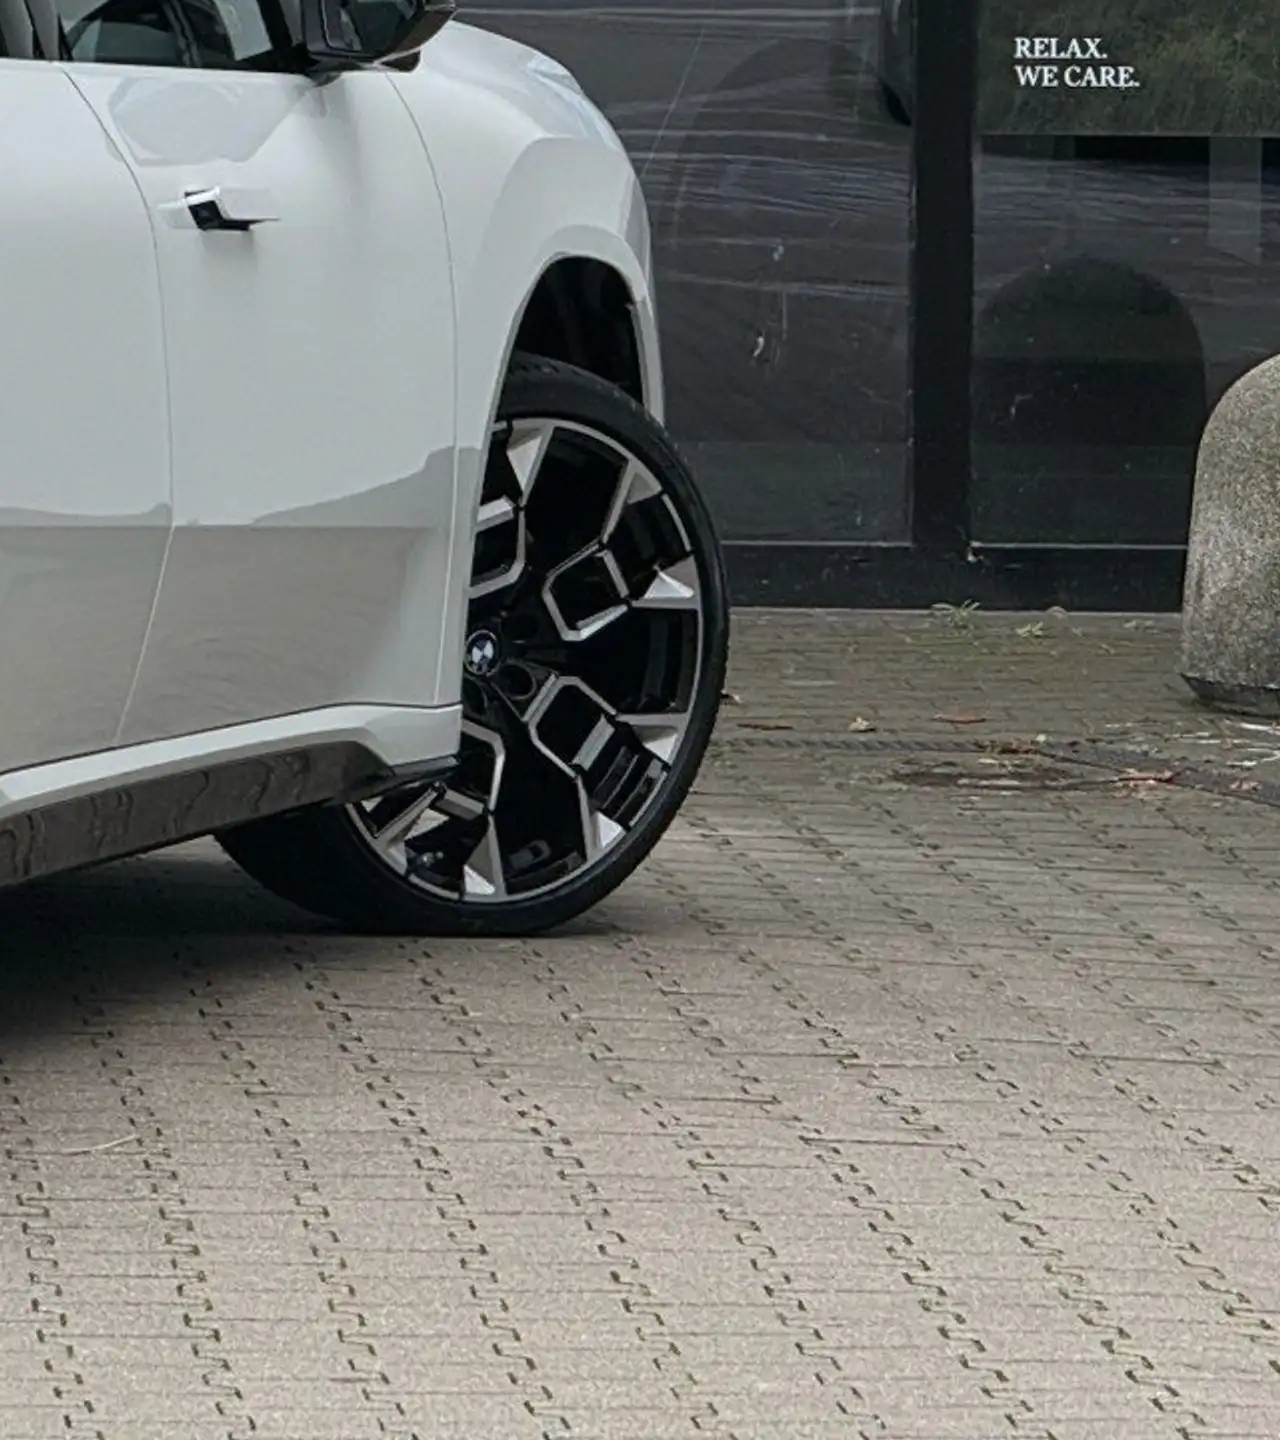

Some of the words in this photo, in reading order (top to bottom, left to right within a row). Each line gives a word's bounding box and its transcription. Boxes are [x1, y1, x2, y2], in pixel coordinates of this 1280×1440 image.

[1014, 37, 1108, 60] RELAX.
[1015, 65, 1059, 87] WE
[1063, 65, 1141, 88] CARE.
